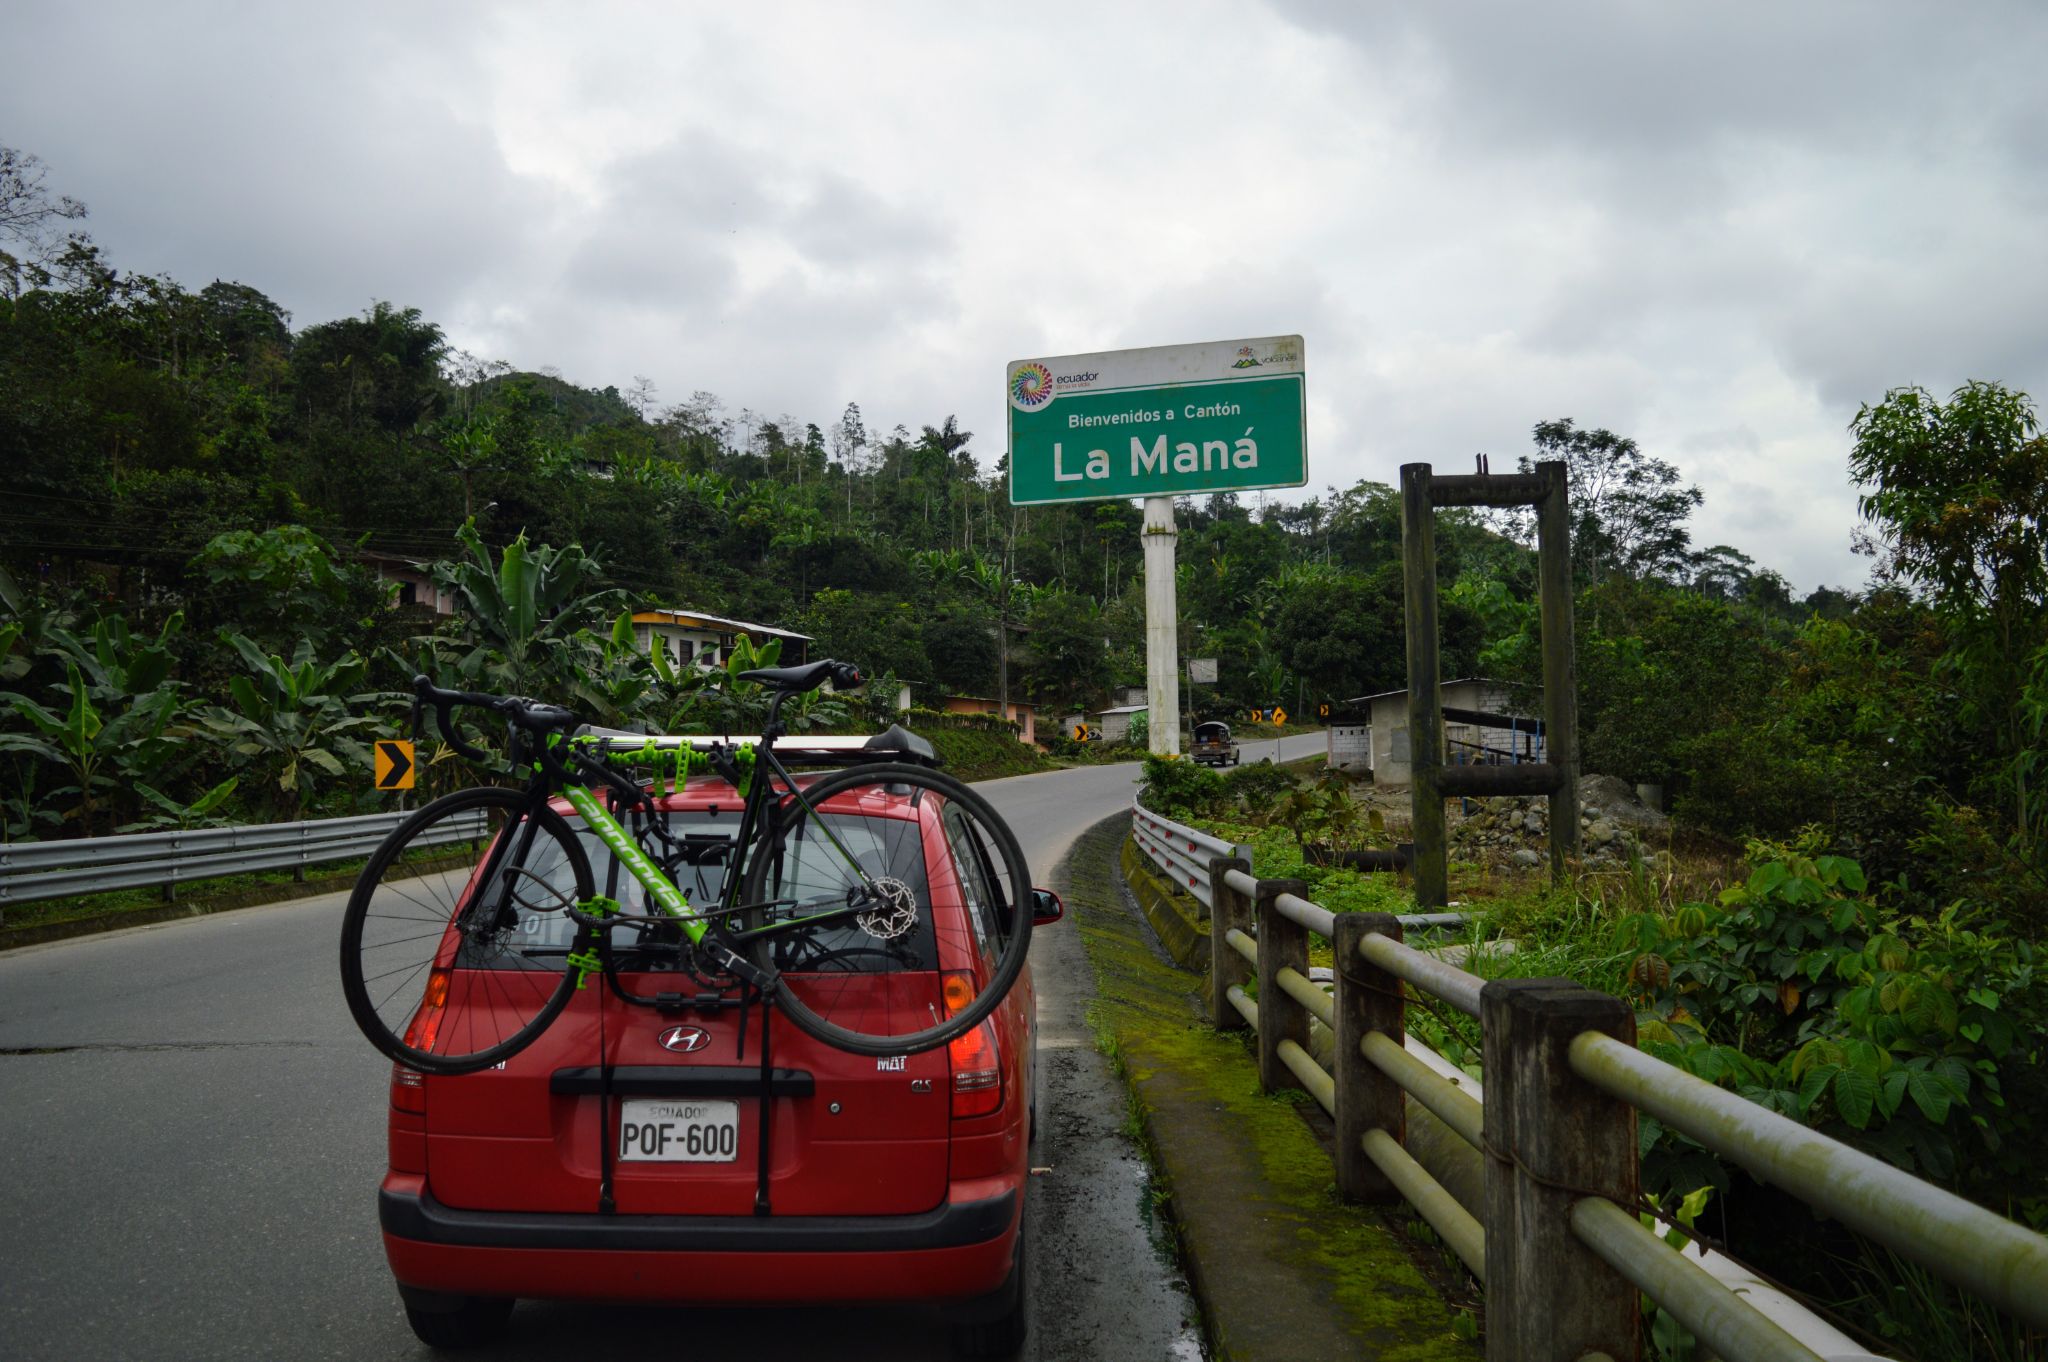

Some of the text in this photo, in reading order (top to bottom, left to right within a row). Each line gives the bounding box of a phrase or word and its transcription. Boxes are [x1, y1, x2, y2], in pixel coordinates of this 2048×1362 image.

[1056, 371, 1099, 384] ecuador
[1068, 401, 1241, 428] Bienvenidos a Cantón
[1054, 426, 1258, 482] La Maná
[622, 1123, 735, 1155] POF-600
